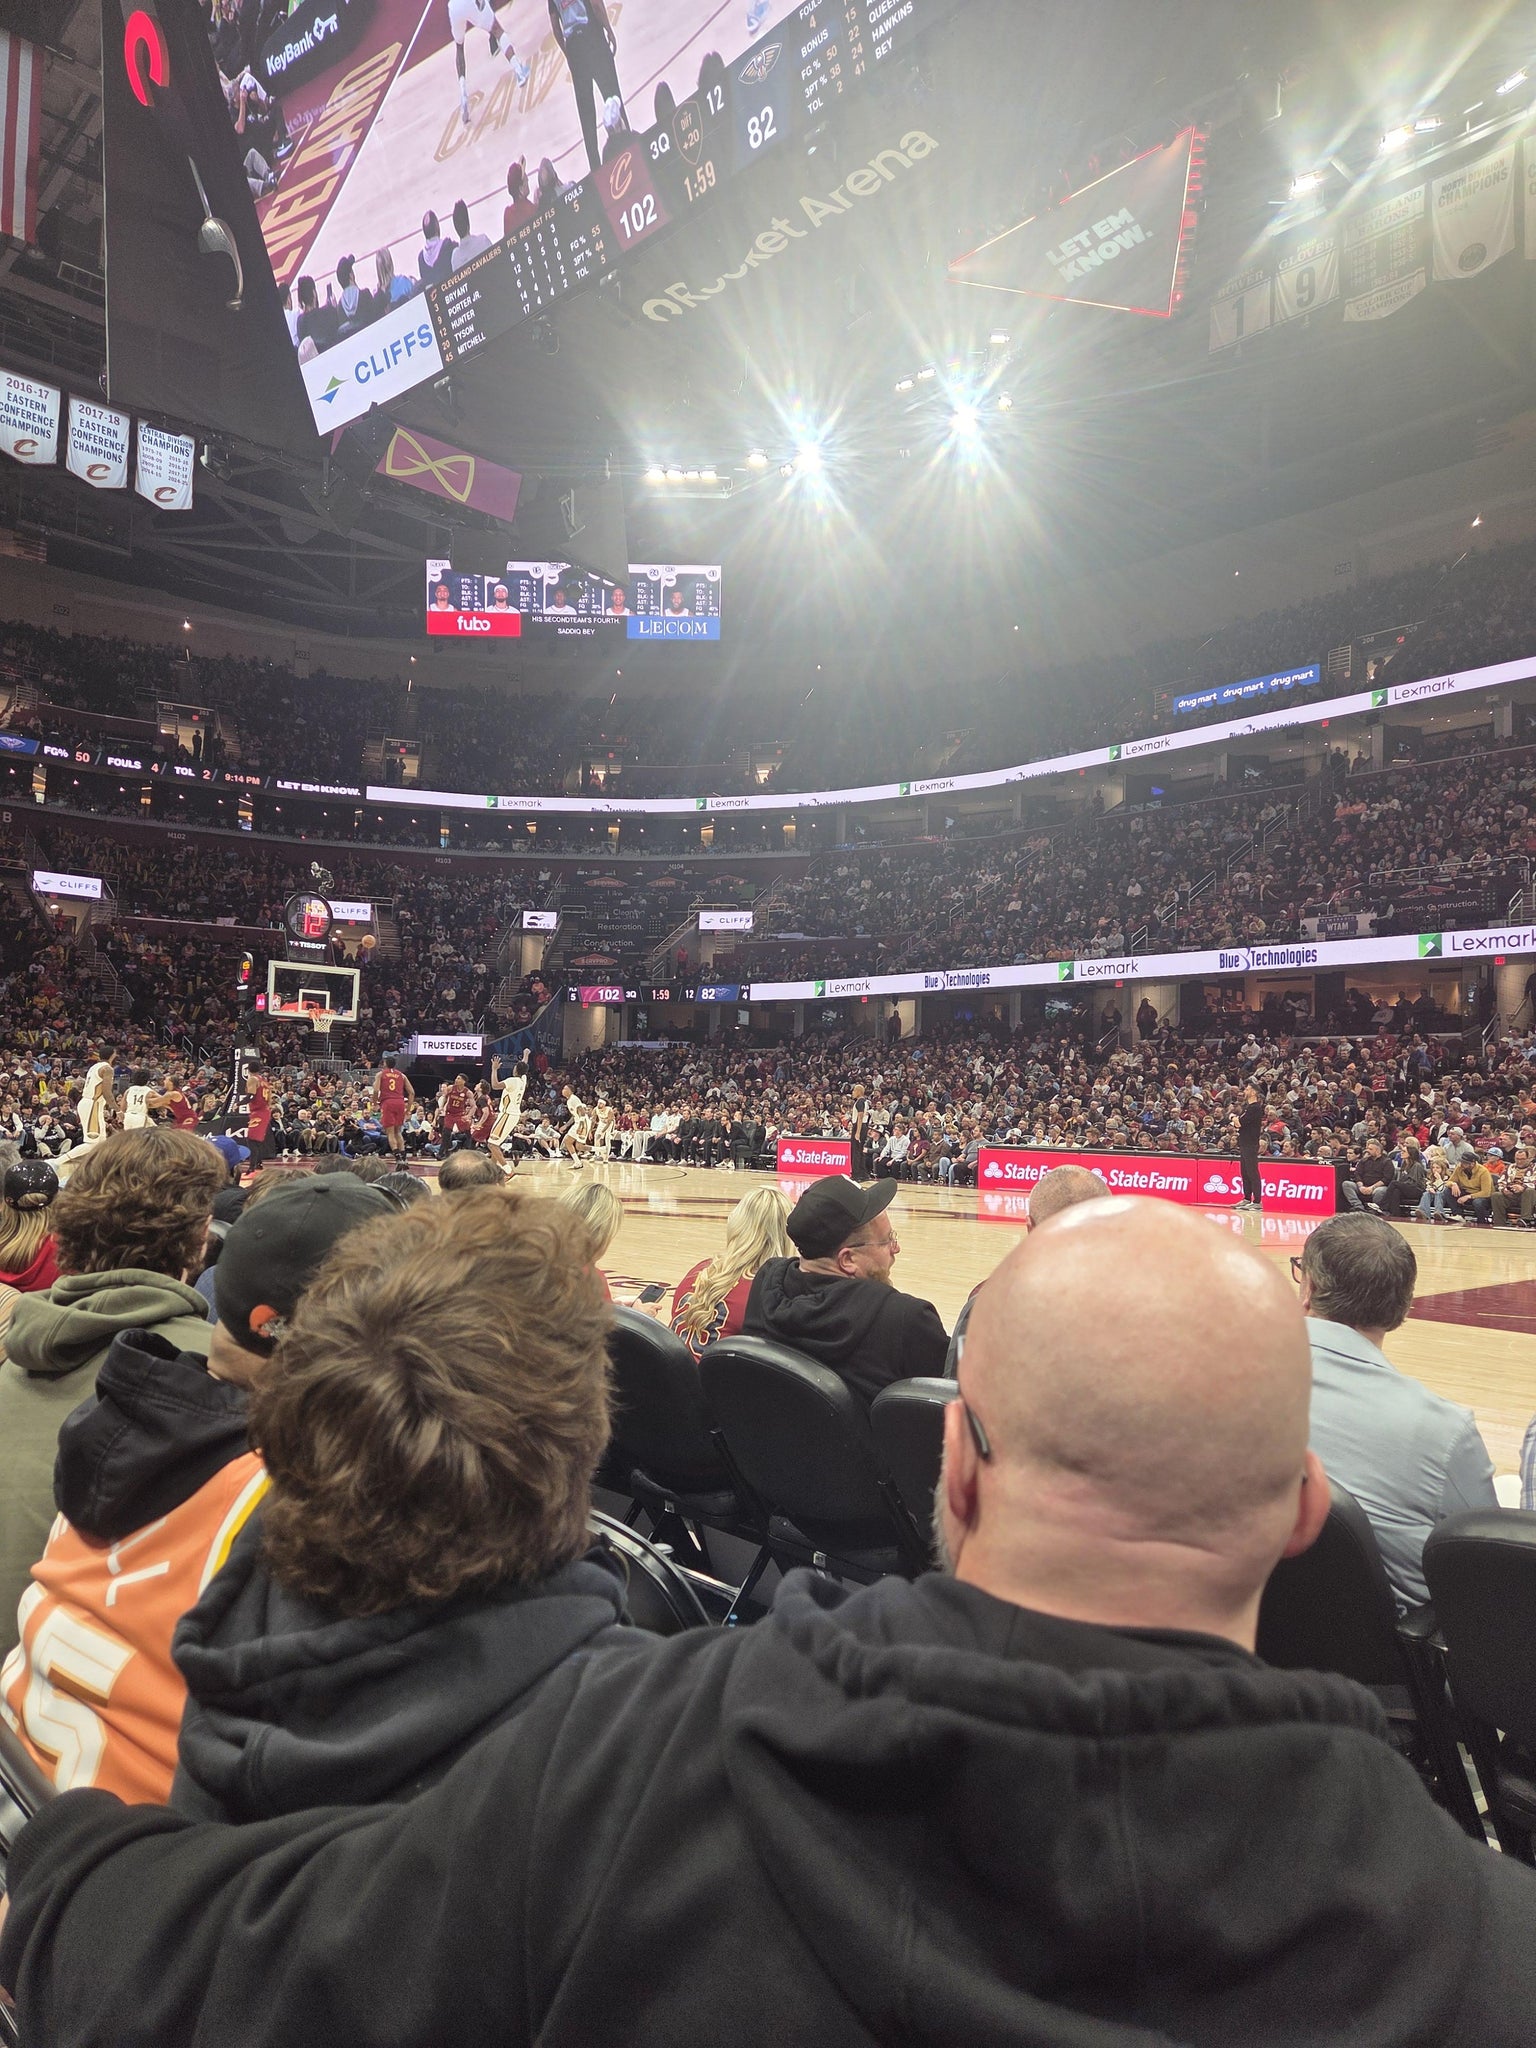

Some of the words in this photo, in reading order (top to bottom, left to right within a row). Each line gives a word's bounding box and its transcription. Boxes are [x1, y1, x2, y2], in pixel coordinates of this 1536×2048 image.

[809, 14, 817, 29] 4
[845, 6, 857, 24] 15
[871, 1, 914, 42] HAWKINS
[801, 28, 829, 58] BONUS
[848, 25, 860, 42] 22
[266, 31, 314, 77] KeyBank
[851, 41, 863, 60] 24
[875, 36, 893, 60] BEY
[801, 64, 813, 80] FG
[812, 58, 821, 71] %
[826, 44, 838, 61] 50
[855, 60, 866, 76] 41
[804, 79, 819, 98] 3PT
[818, 74, 828, 86] %
[829, 63, 841, 79] 38
[706, 85, 725, 115] 12
[807, 97, 824, 114] TOL
[836, 80, 843, 94] 2
[683, 128, 700, 150] +20
[747, 106, 777, 149] 82
[650, 132, 671, 160] 3Q
[684, 160, 717, 202] 1:59
[800, 131, 939, 228] Arena
[1467, 159, 1505, 182] DIVISION
[564, 185, 584, 205] FOULS
[1438, 167, 1508, 208] CHAMPIONS
[573, 201, 581, 213] 5
[620, 194, 658, 239] 102
[570, 240, 579, 252] FG
[591, 224, 601, 238] 55
[1045, 229, 1092, 266] LET
[1091, 207, 1135, 240] EM
[441, 267, 472, 292] CLEVELAND
[472, 247, 502, 272] CAVALIERS
[506, 236, 517, 248] PTS
[519, 225, 531, 240] REB
[532, 217, 543, 231] AST
[545, 208, 556, 221] FLS
[573, 254, 585, 267] 3PT
[1058, 224, 1154, 283] KNOW.
[434, 304, 440, 312] 3
[444, 283, 469, 305] BRYANT
[510, 253, 516, 262] 8
[524, 243, 530, 252] 3
[537, 233, 543, 243] 0
[550, 224, 556, 234] 3
[575, 266, 590, 281] TOL
[437, 317, 443, 325] 9
[447, 297, 472, 318] PORTER
[472, 291, 482, 302] JR.
[513, 264, 522, 275] 12
[527, 256, 533, 265] 6
[553, 238, 559, 247] 0
[1296, 266, 1316, 308] 9
[439, 328, 448, 338] 12
[450, 309, 476, 330] HUNTER
[516, 279, 522, 289] 6
[556, 251, 562, 261] 0
[442, 339, 450, 351] 20
[454, 324, 475, 342] TYSON
[519, 290, 528, 302] 14
[533, 282, 539, 292] 4
[559, 265, 565, 275] 2
[1232, 295, 1244, 338] 1
[445, 352, 454, 363] 45
[456, 332, 486, 355] MITCHELL
[522, 303, 531, 316] 17
[562, 279, 569, 288] 2
[355, 323, 433, 384] CLIFFS
[6, 377, 49, 400] 2016-17
[0, 401, 55, 428] CONFERENCE
[7, 392, 47, 414] EASTERN
[78, 403, 121, 426] 2017-18
[0, 414, 52, 439] CHAMPIONS
[79, 418, 118, 439] EASTERN
[139, 426, 166, 441] CENTRAL
[168, 434, 194, 449] DIVISION
[71, 427, 126, 454] CONFERENCE
[142, 434, 191, 458] CHAMPIONS
[73, 440, 123, 465] CHAMPIONS
[457, 615, 491, 631] fubo
[557, 627, 582, 635] SADDIQ
[1222, 687, 1242, 699] drug
[1243, 681, 1264, 694] mart
[1270, 675, 1291, 688] drug
[1292, 669, 1314, 683] mart
[1394, 677, 1455, 701] Lexmark
[1177, 697, 1198, 709] drug
[1198, 691, 1217, 704] mart
[1125, 737, 1171, 757] Lexmark
[44, 745, 69, 759] FG%
[75, 751, 90, 764] 50
[107, 757, 142, 771] FOULS
[151, 763, 159, 774] 4
[174, 765, 196, 778] TOL
[202, 769, 211, 781] 2
[225, 773, 245, 784] 9:14
[246, 775, 261, 786] PM
[277, 779, 300, 791] LET
[300, 783, 321, 793] EM
[321, 784, 361, 796] KNOW.
[915, 779, 954, 793] Lexmark
[502, 797, 543, 808] Lexmark
[711, 797, 750, 808] Lexmark
[2, 811, 12, 825] B
[60, 880, 99, 893] CLIFFS
[334, 907, 368, 915] CLIFFS
[597, 923, 644, 931] Restoration.
[300, 941, 327, 950] TISSOT
[1452, 929, 1536, 951] Lexmark
[1081, 957, 1139, 977] Lexmark
[1219, 952, 1240, 971] Blue
[1250, 946, 1318, 968] Technologies
[829, 979, 871, 994] Lexmark
[925, 974, 940, 989] Blue
[946, 971, 991, 988] Technologies
[571, 993, 577, 1001] 5
[598, 989, 620, 1000] 102
[625, 990, 637, 999] 3Q
[652, 989, 670, 1000] 1:59
[685, 989, 694, 999] 12
[701, 988, 716, 1000] 82
[742, 992, 748, 1000] 4
[423, 1041, 478, 1050] TRUSTEDSEC
[388, 1078, 396, 1091] 3
[133, 1094, 144, 1105] 14
